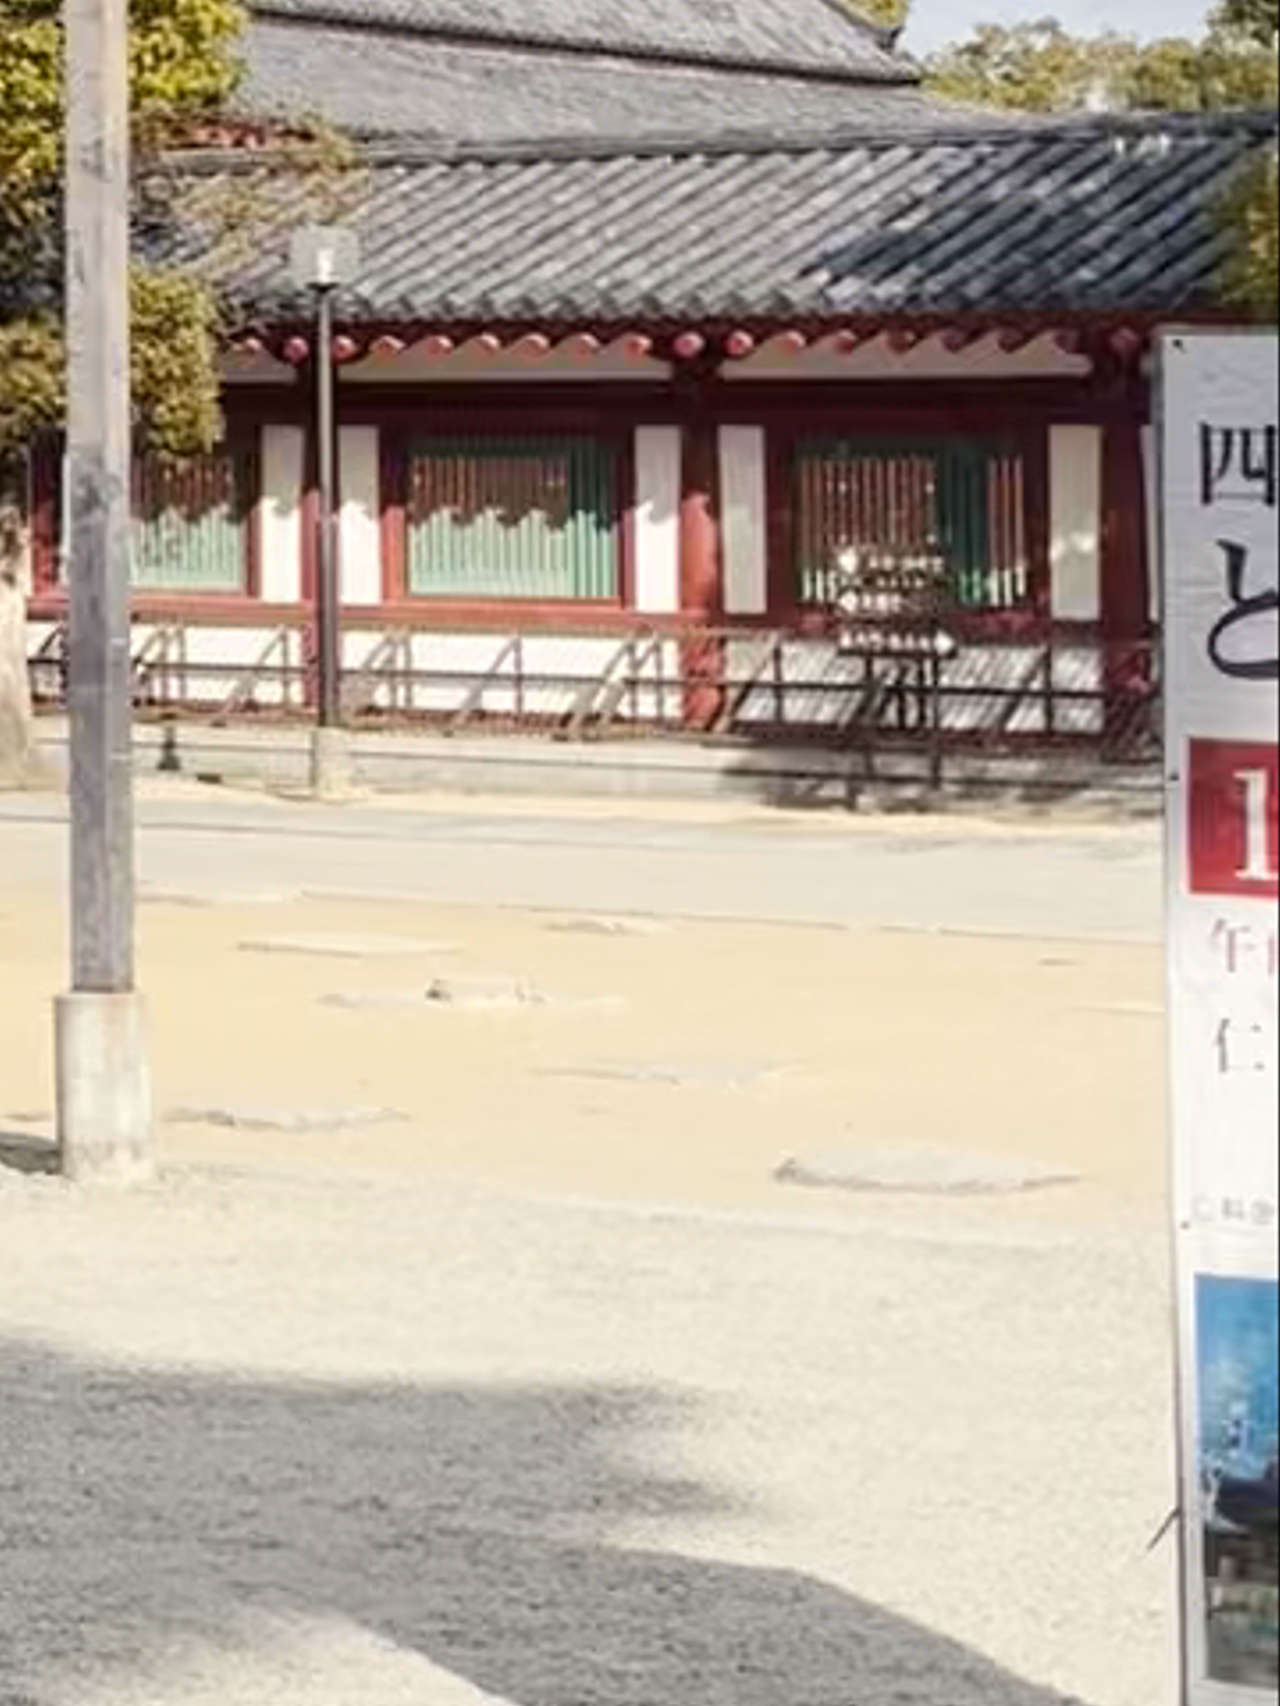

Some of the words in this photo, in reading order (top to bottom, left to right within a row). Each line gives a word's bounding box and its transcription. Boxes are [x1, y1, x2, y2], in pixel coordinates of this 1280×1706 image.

[1200, 422, 1277, 507] 四
[1206, 539, 1279, 679] と
[1233, 767, 1278, 881] 1
[1210, 917, 1277, 977] 午
[1213, 1017, 1266, 1074] 仁
